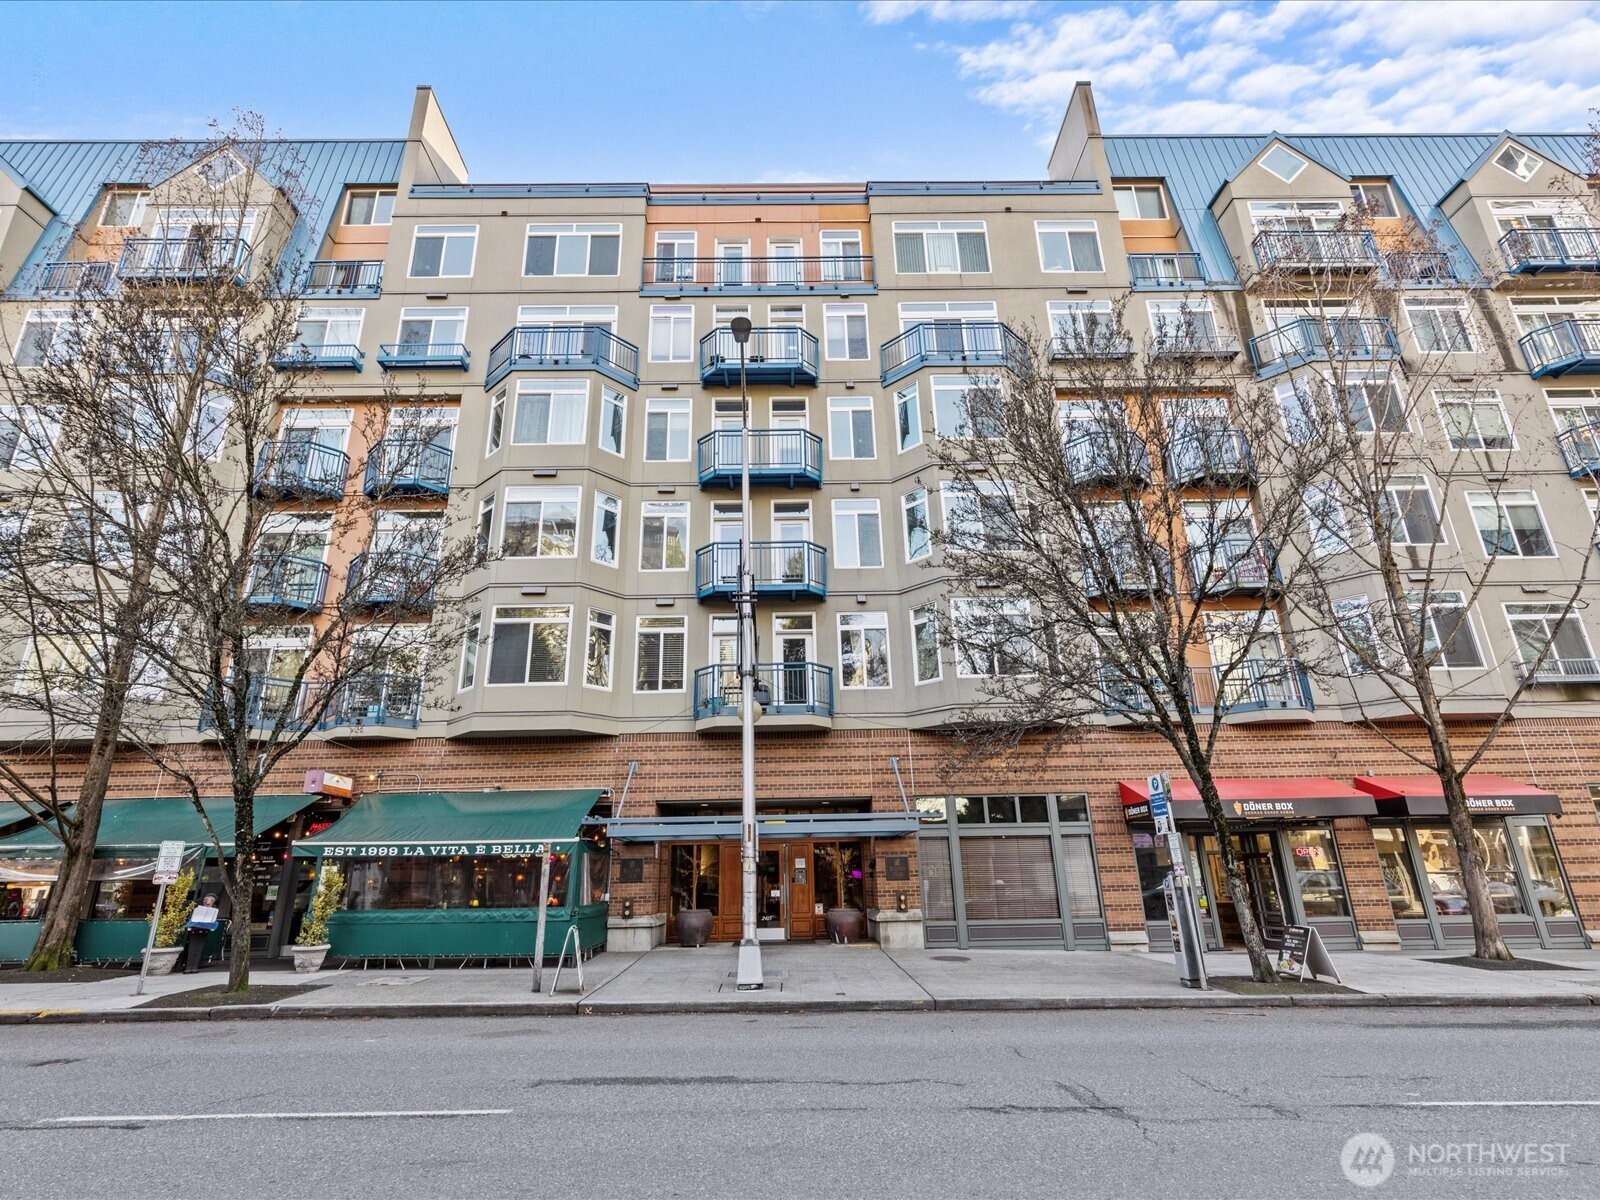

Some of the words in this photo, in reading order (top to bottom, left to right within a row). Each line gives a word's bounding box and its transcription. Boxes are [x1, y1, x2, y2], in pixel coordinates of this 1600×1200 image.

[1243, 801, 1273, 810] DÖNER
[1275, 802, 1293, 810] BOX
[1495, 799, 1514, 807] BOX
[1140, 805, 1148, 813] BOX
[323, 847, 356, 856] EST
[360, 846, 398, 856] 1999
[403, 846, 425, 856] LA
[430, 846, 469, 855] VITA
[491, 844, 545, 854] BELLA
[1296, 848, 1320, 856] OPEN
